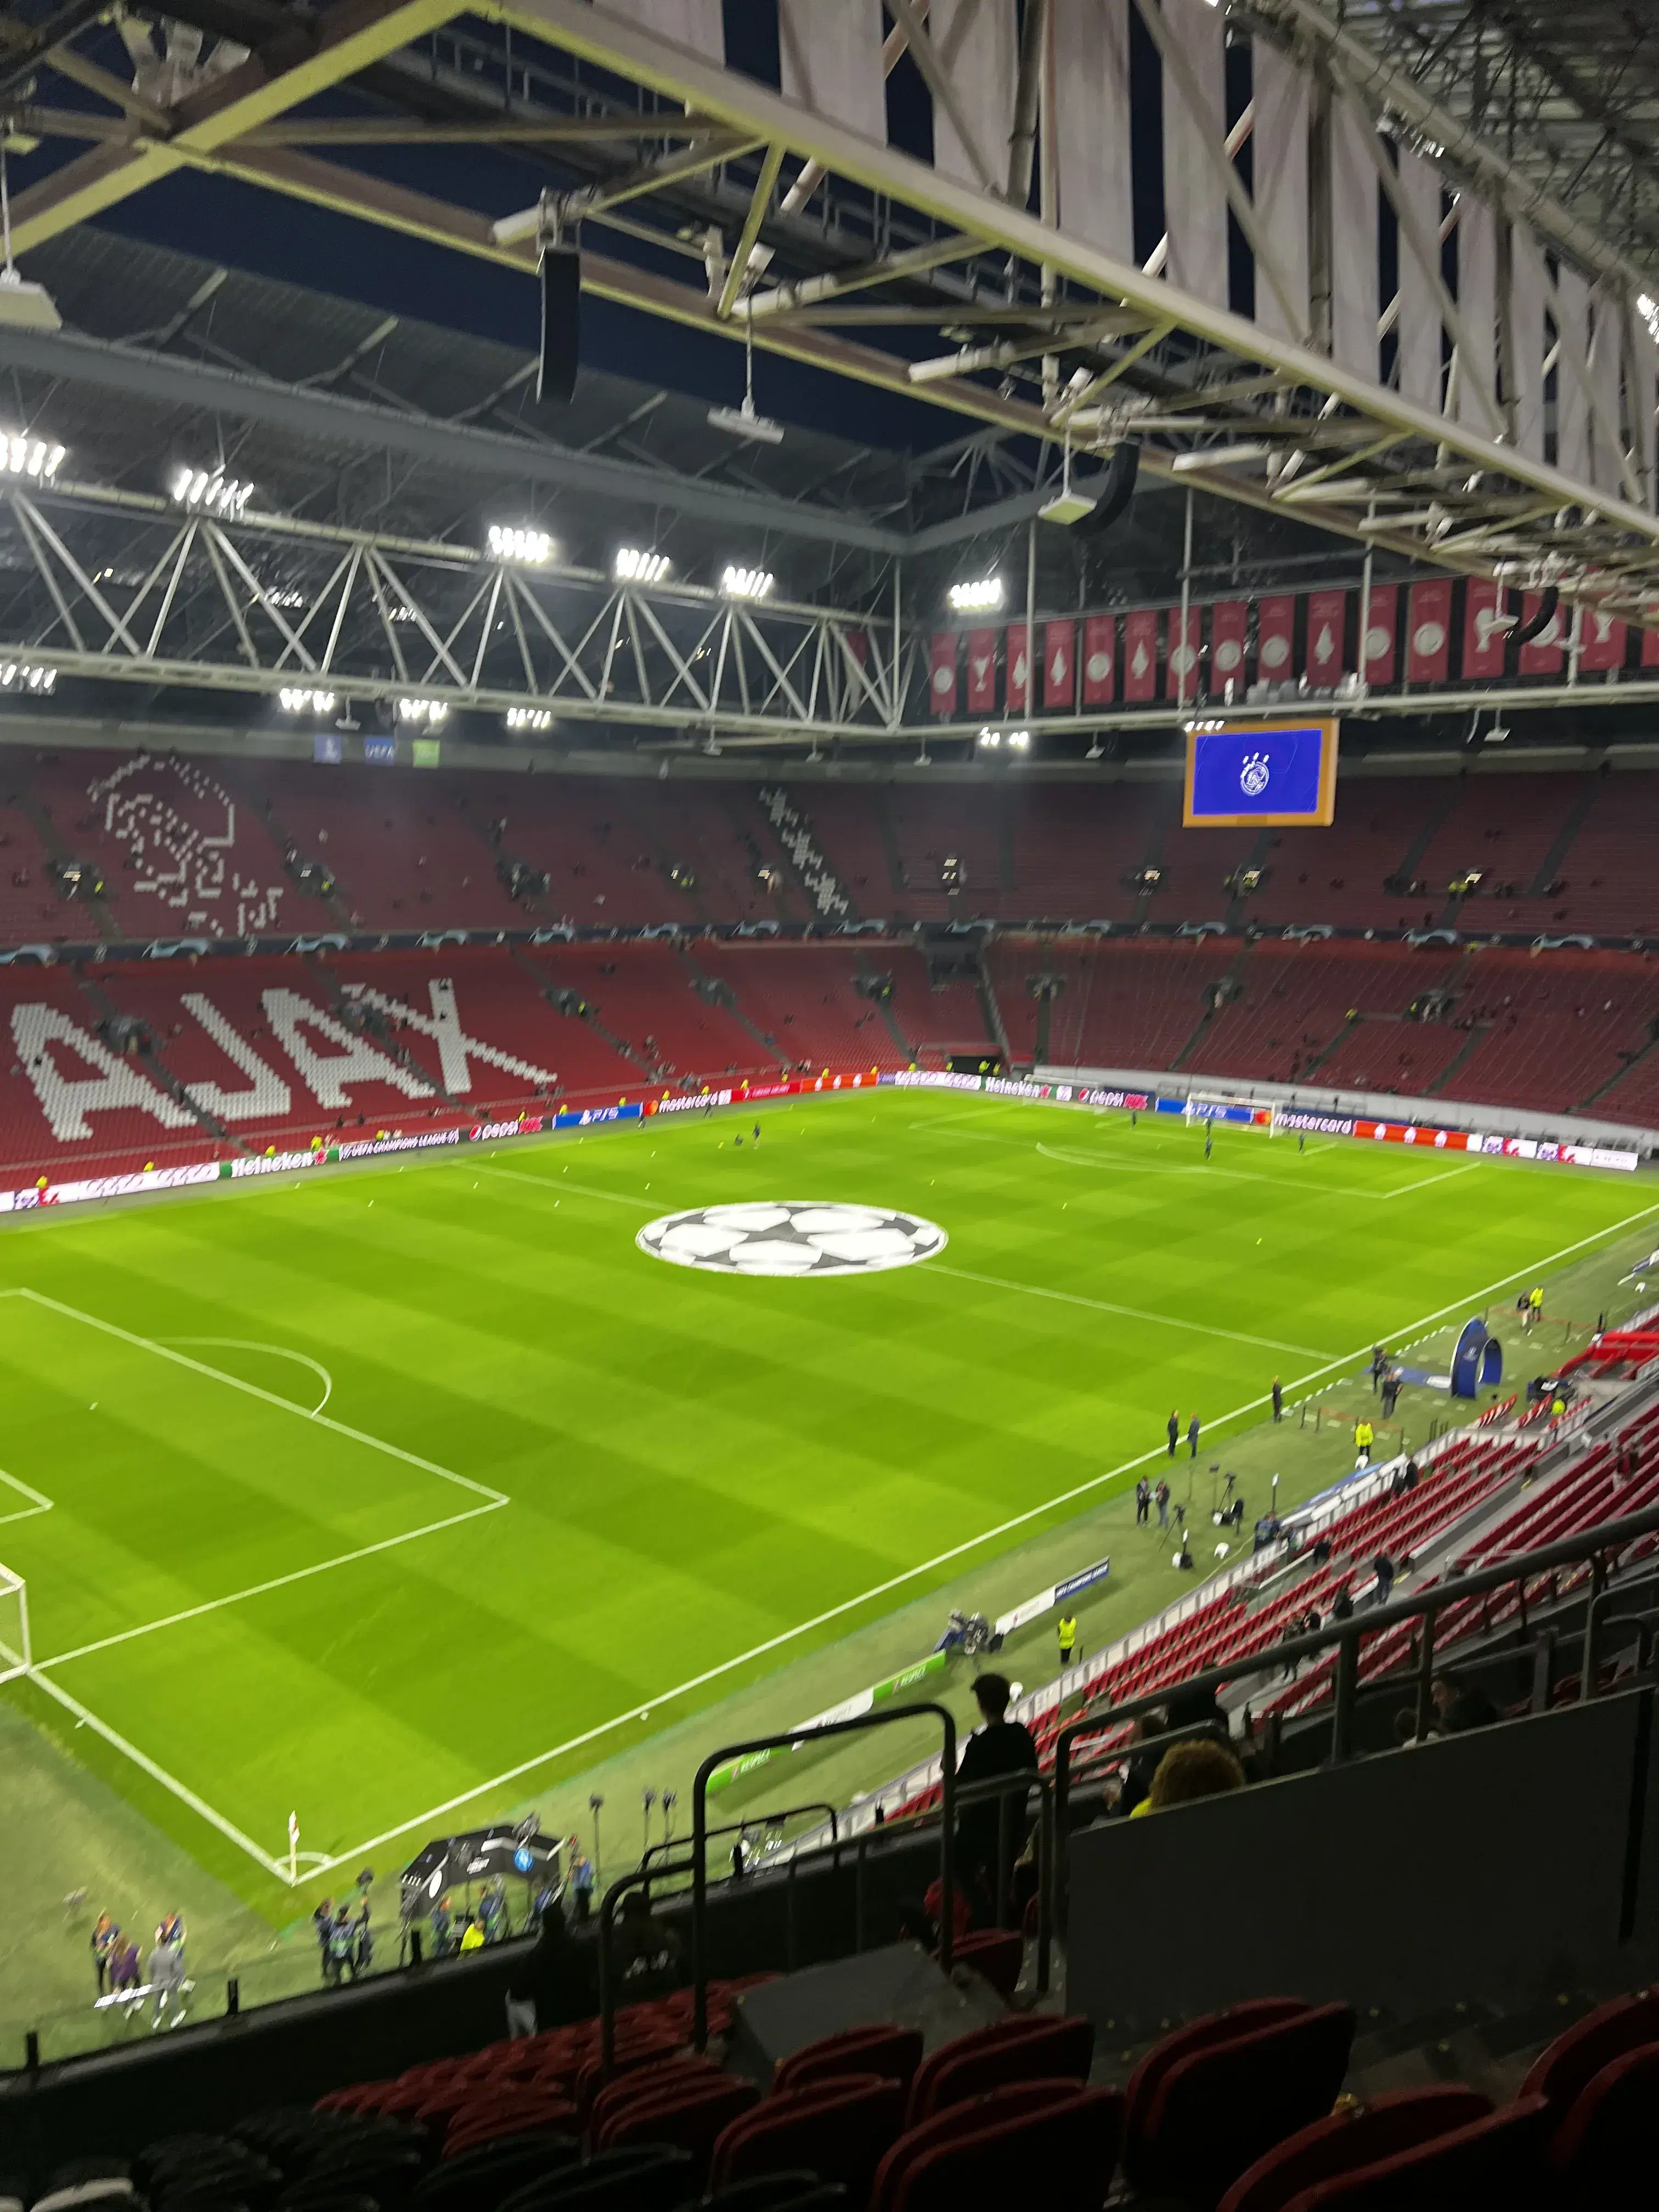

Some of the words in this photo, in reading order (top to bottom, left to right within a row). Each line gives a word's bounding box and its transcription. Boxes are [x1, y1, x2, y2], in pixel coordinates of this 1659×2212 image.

[10, 978, 557, 1142] AJAX
[659, 1091, 719, 1113] mastercard
[1274, 1112, 1352, 1135] mastercard
[230, 1150, 314, 1178] Heineken
